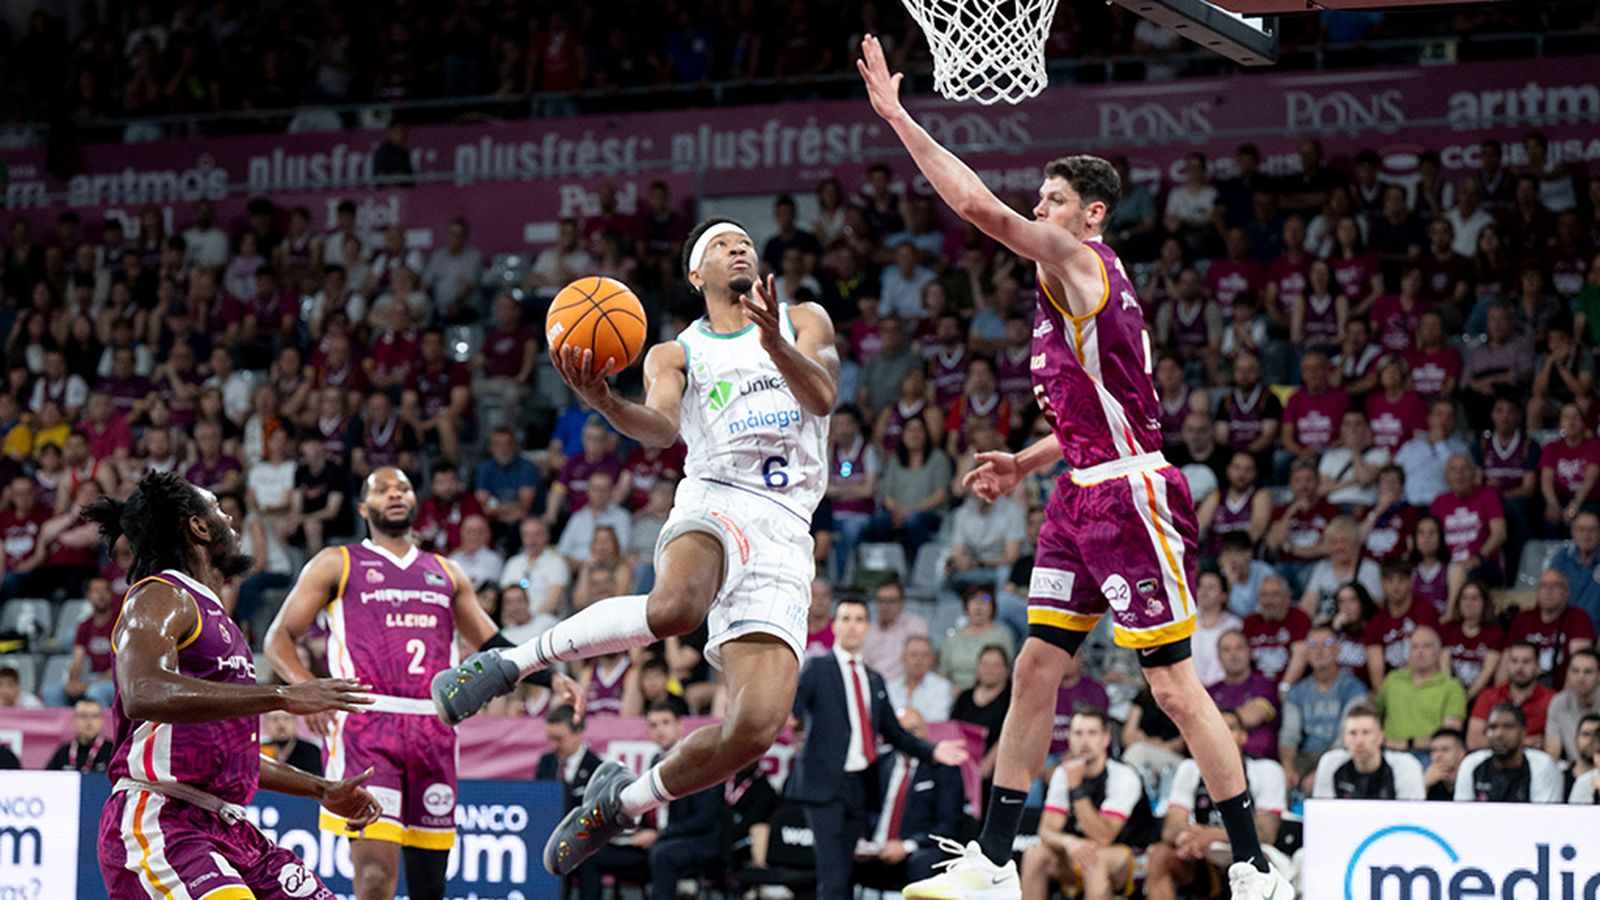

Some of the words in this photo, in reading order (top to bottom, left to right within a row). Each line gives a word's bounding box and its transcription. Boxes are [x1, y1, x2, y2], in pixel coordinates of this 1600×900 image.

[1099, 101, 1214, 148] PONS
[1284, 89, 1404, 138] PONS
[728, 409, 800, 435] málaga
[762, 455, 789, 489] 6
[405, 638, 427, 675] 2
